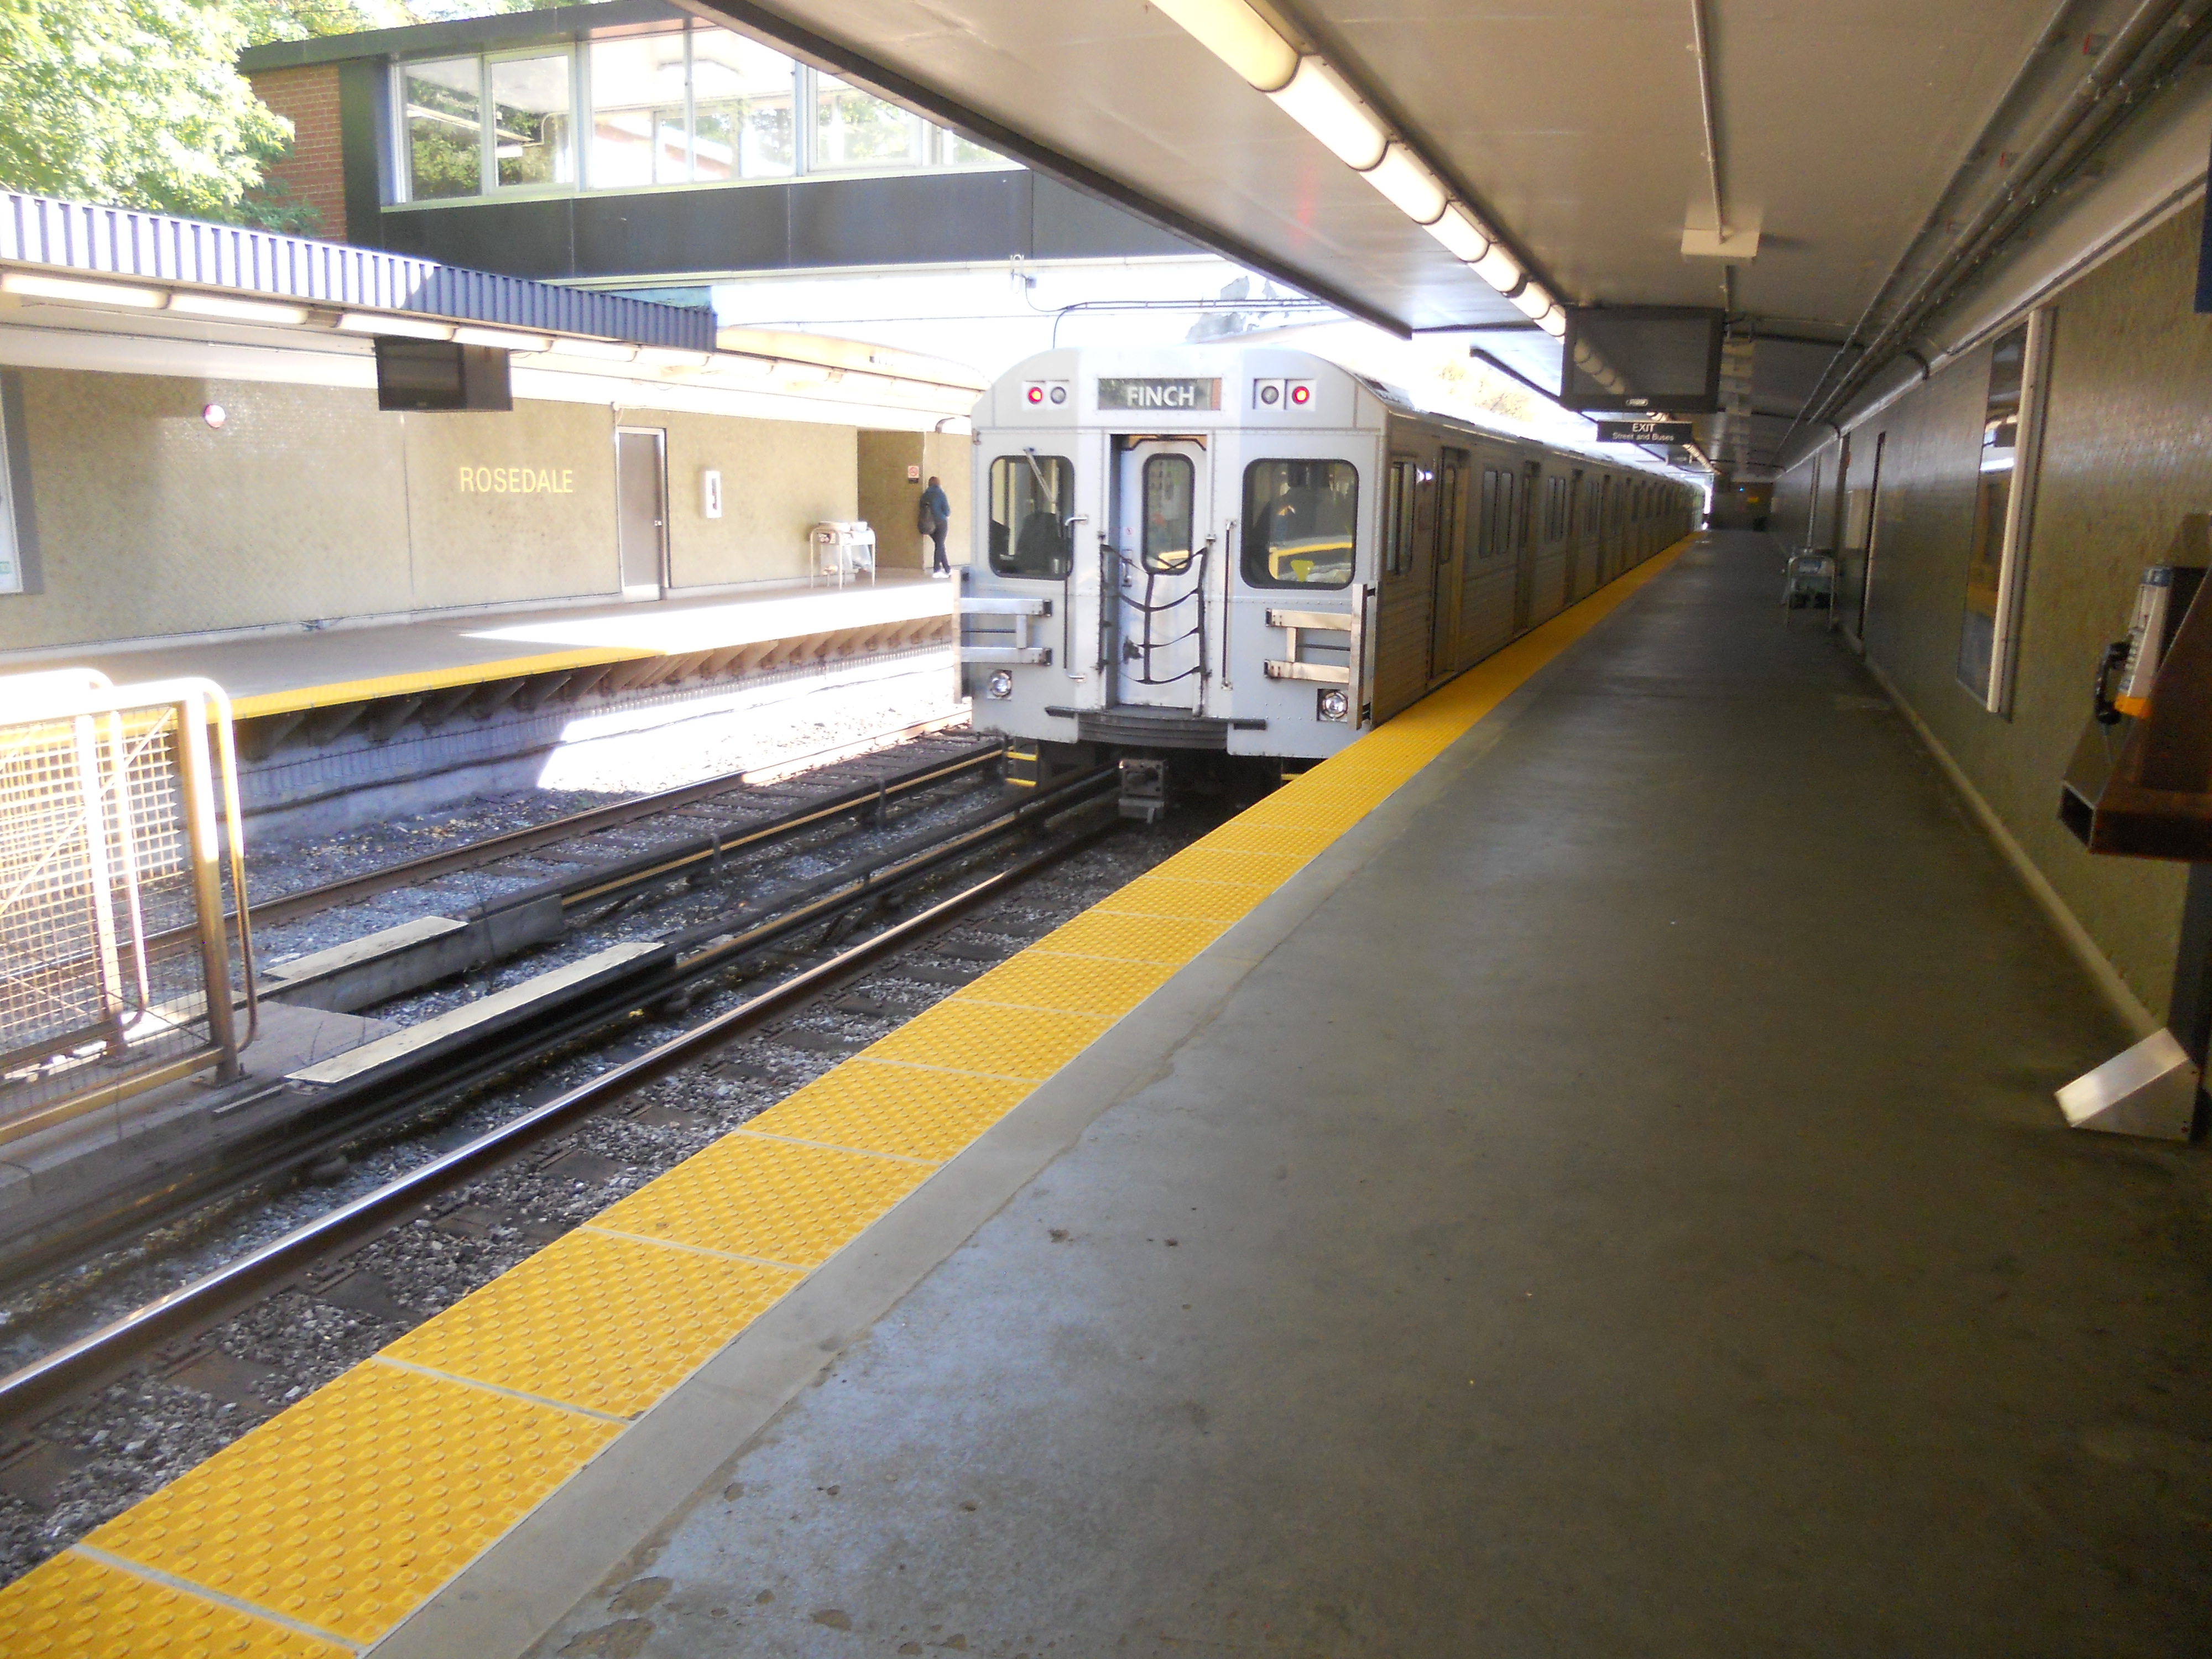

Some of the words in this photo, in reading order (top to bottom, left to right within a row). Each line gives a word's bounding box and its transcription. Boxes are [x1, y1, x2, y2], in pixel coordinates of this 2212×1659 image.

[1126, 385, 1194, 406] FINCH
[1632, 422, 1656, 432] EXIT
[460, 467, 573, 493] ROSEDALE
